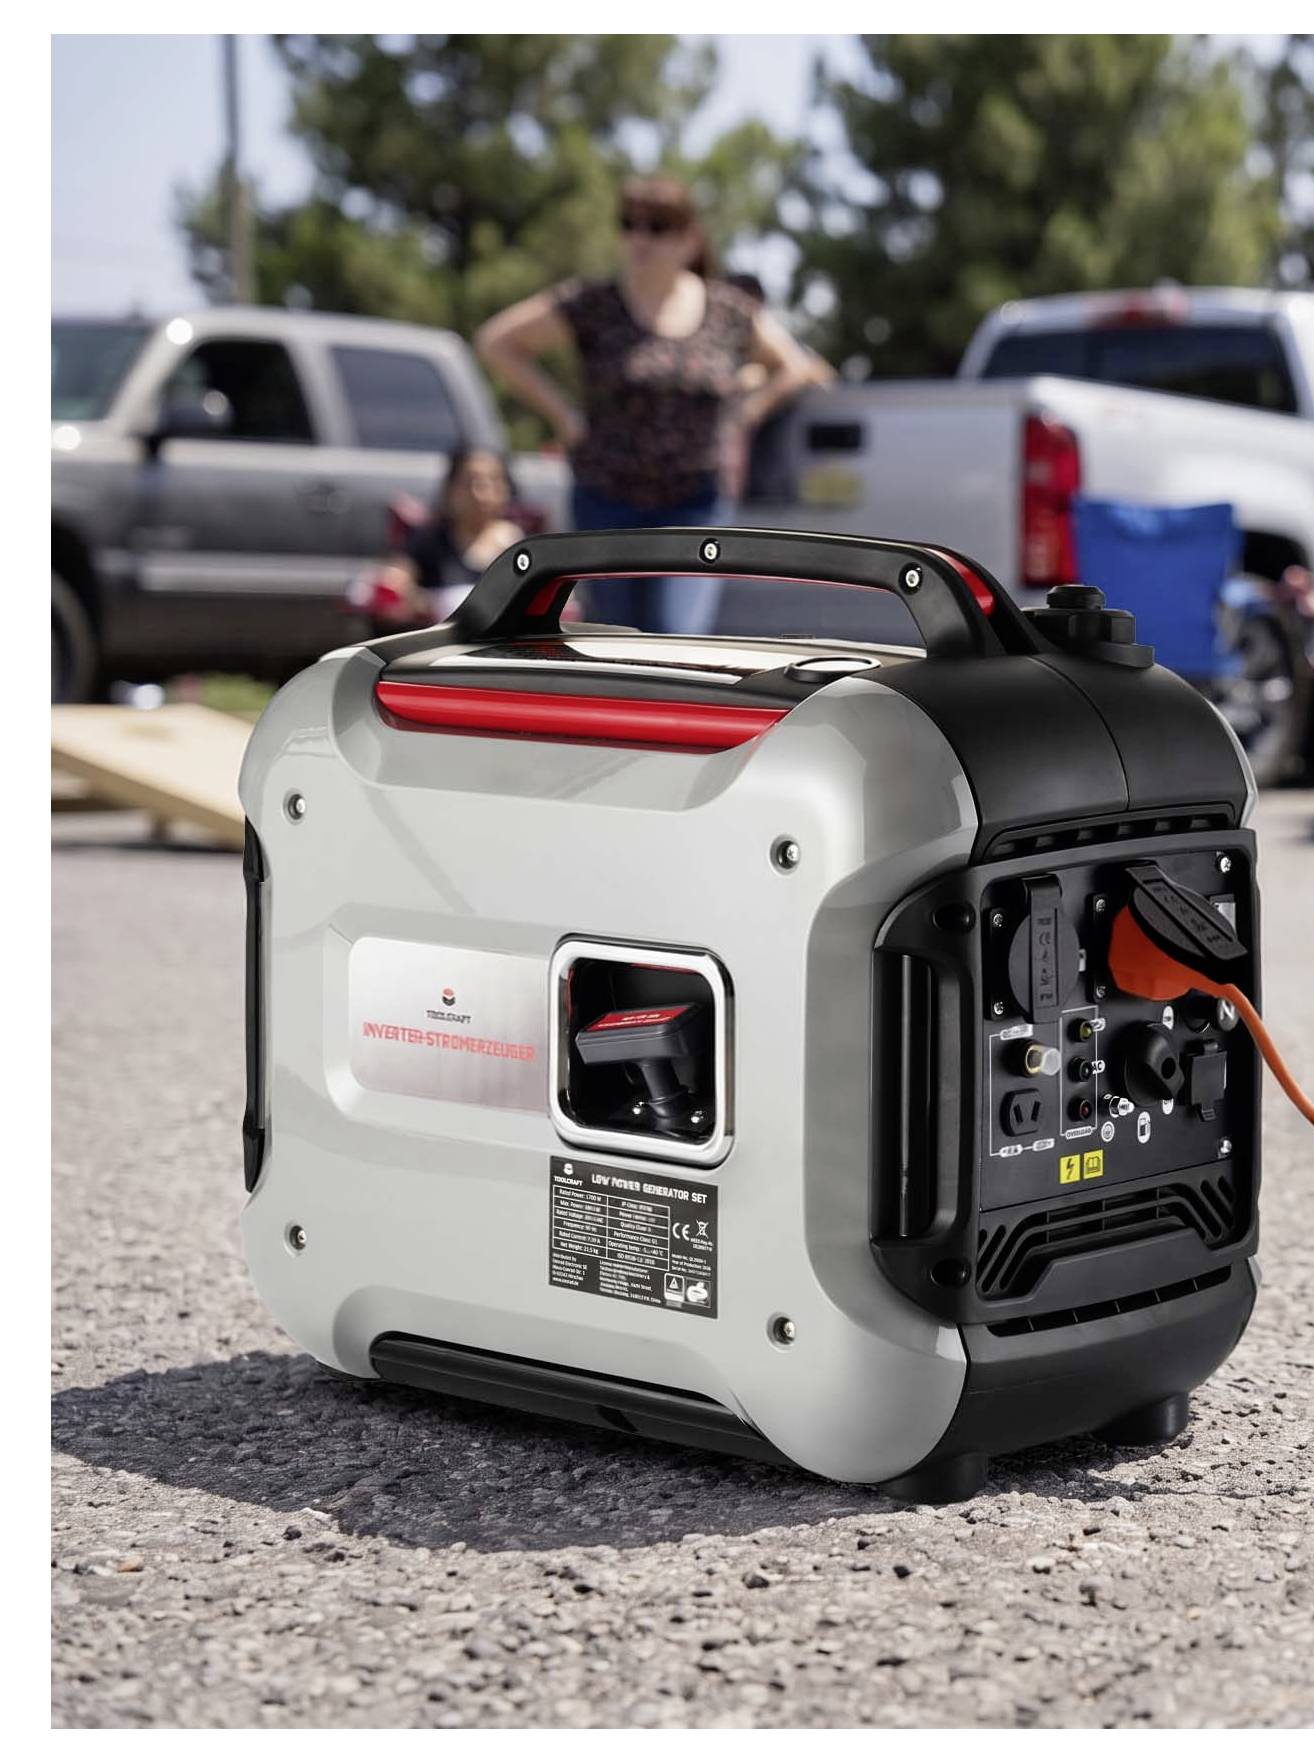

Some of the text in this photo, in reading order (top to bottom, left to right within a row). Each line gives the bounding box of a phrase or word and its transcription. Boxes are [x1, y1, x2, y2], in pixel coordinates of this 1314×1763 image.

[363, 1022, 535, 1060] INVERTER-STROMERZEUGER
[554, 1176, 583, 1186] TOOLCRAFT
[592, 1173, 707, 1204] LOW POWER GENERATOR SET
